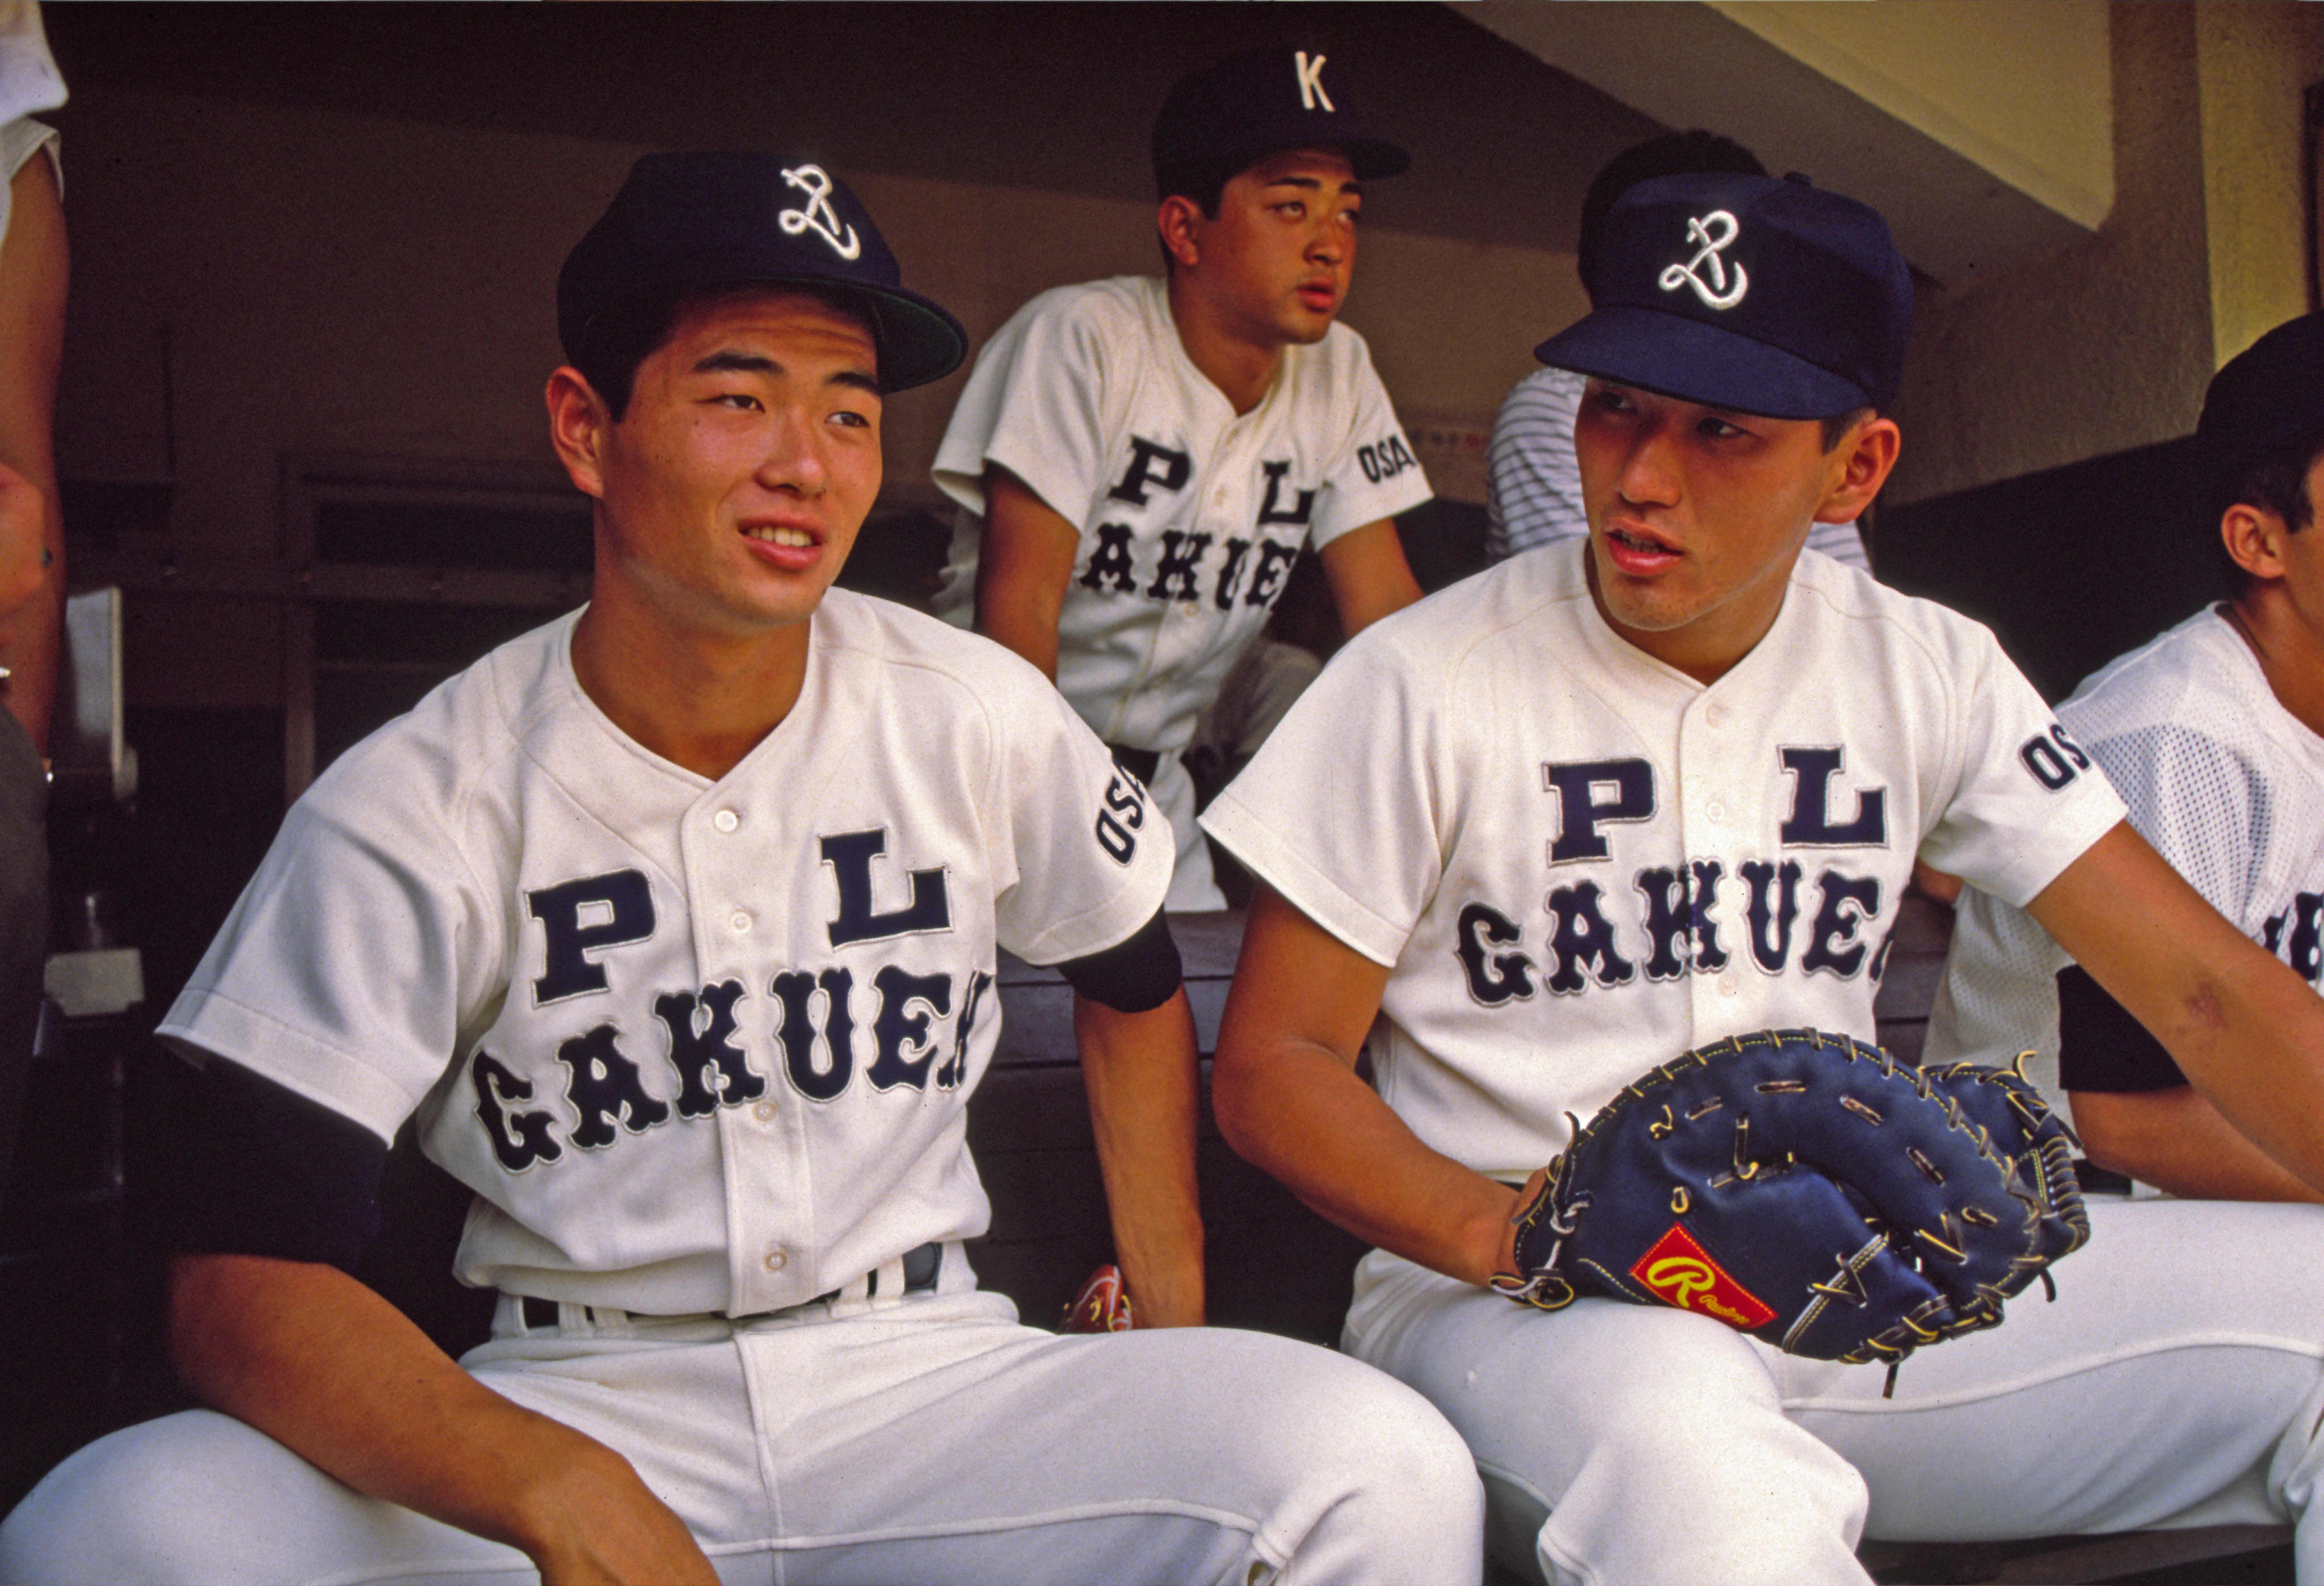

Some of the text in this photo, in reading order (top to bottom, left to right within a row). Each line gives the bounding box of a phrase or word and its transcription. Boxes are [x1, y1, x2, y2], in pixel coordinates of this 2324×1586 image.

[1294, 51, 1335, 112] K
[1454, 859, 1898, 1009] GAKUE
[1647, 1256, 1715, 1308] R
